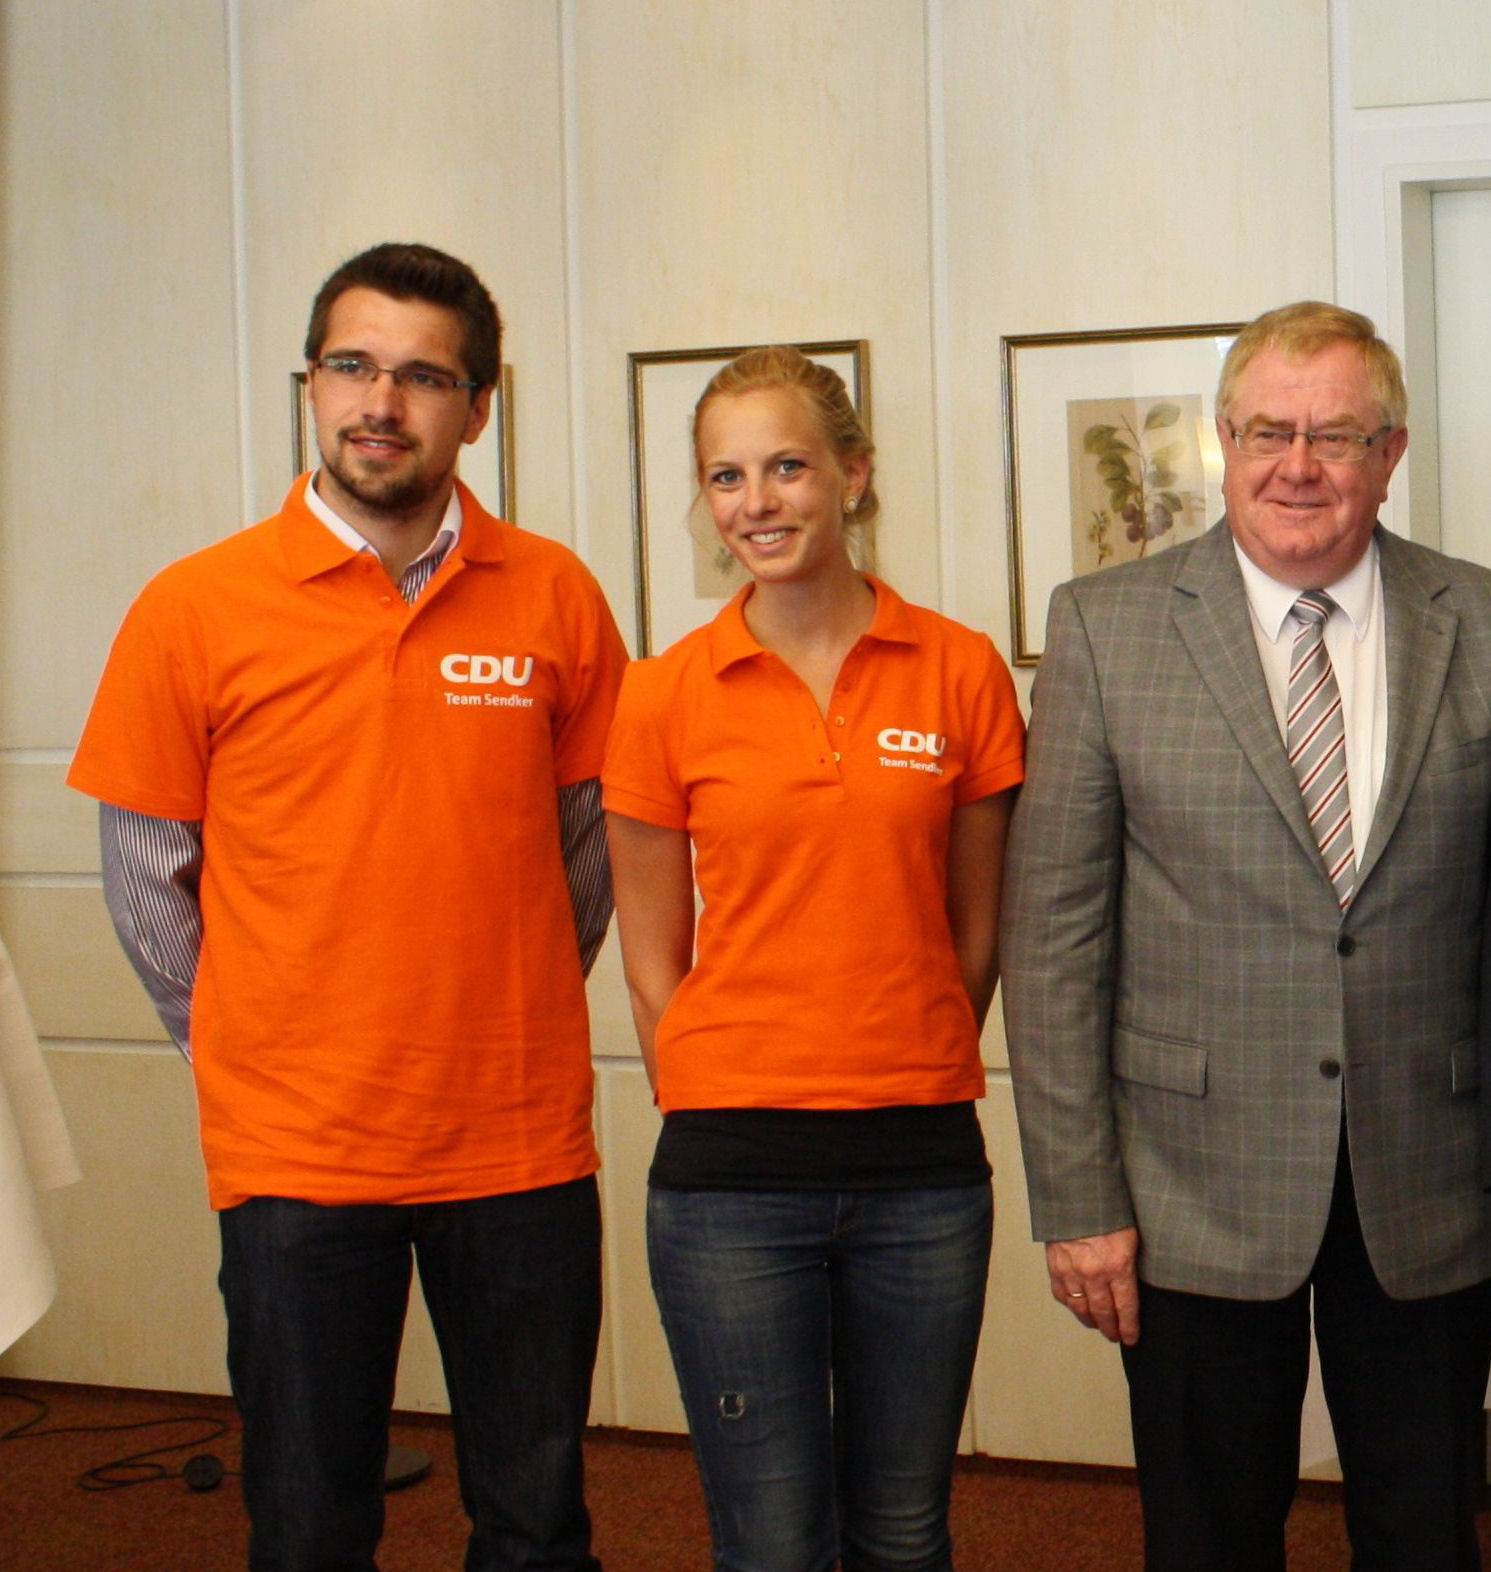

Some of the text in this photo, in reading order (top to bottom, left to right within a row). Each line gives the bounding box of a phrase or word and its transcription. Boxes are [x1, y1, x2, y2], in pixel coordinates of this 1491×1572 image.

[440, 653, 534, 687] CDU
[444, 692, 534, 707] Team Sendker
[877, 728, 946, 757] CDU
[878, 756, 908, 768] Team
